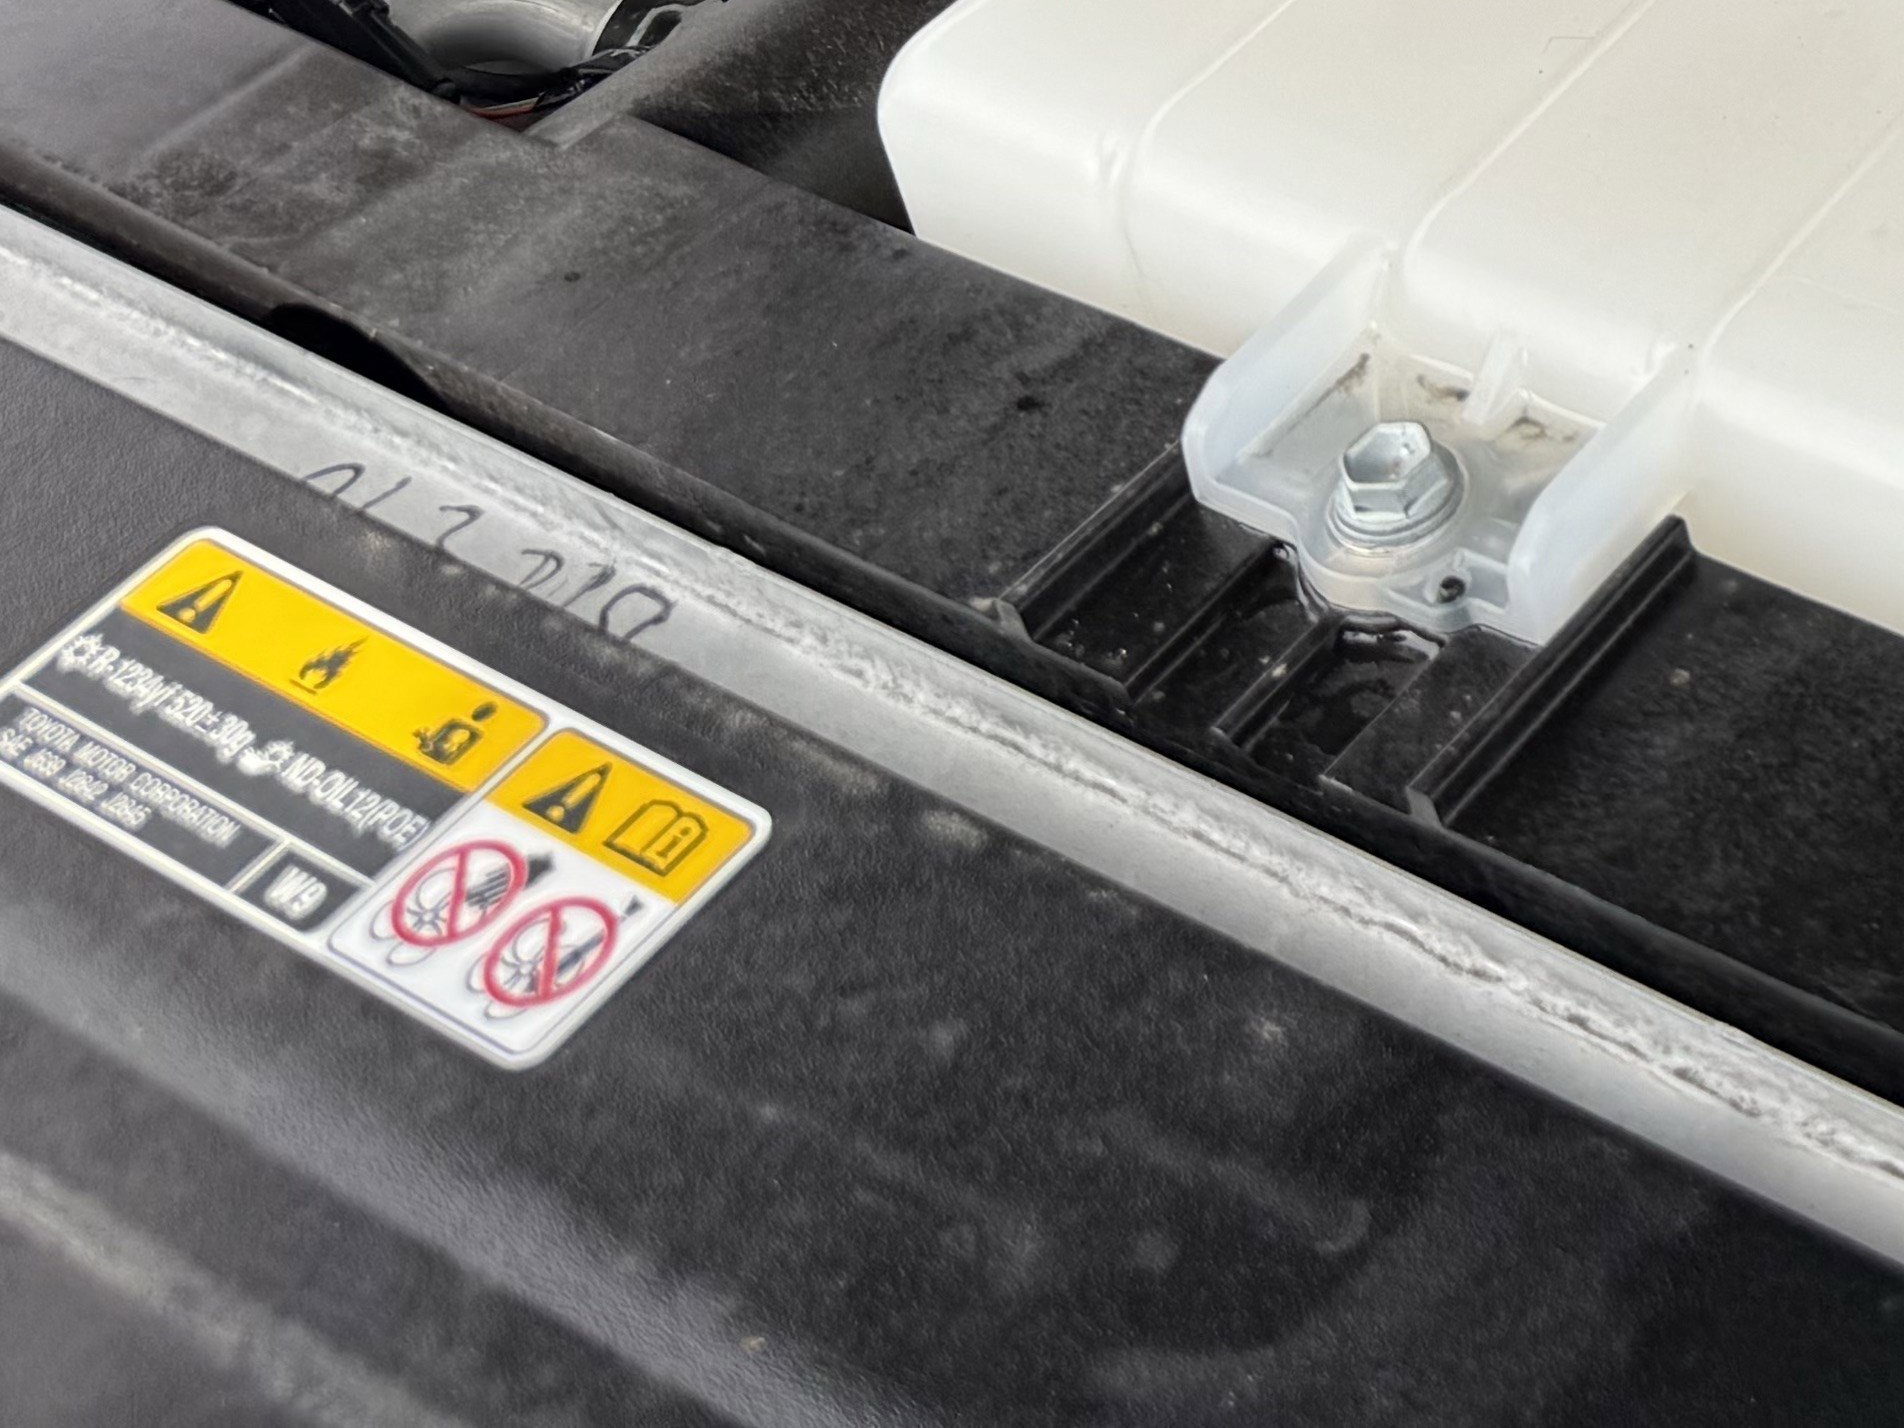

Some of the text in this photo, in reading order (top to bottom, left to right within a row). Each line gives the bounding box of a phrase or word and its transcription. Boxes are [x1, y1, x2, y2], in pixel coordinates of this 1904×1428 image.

[16, 707, 241, 848] TOYOTA MOTOR CORPORATION
